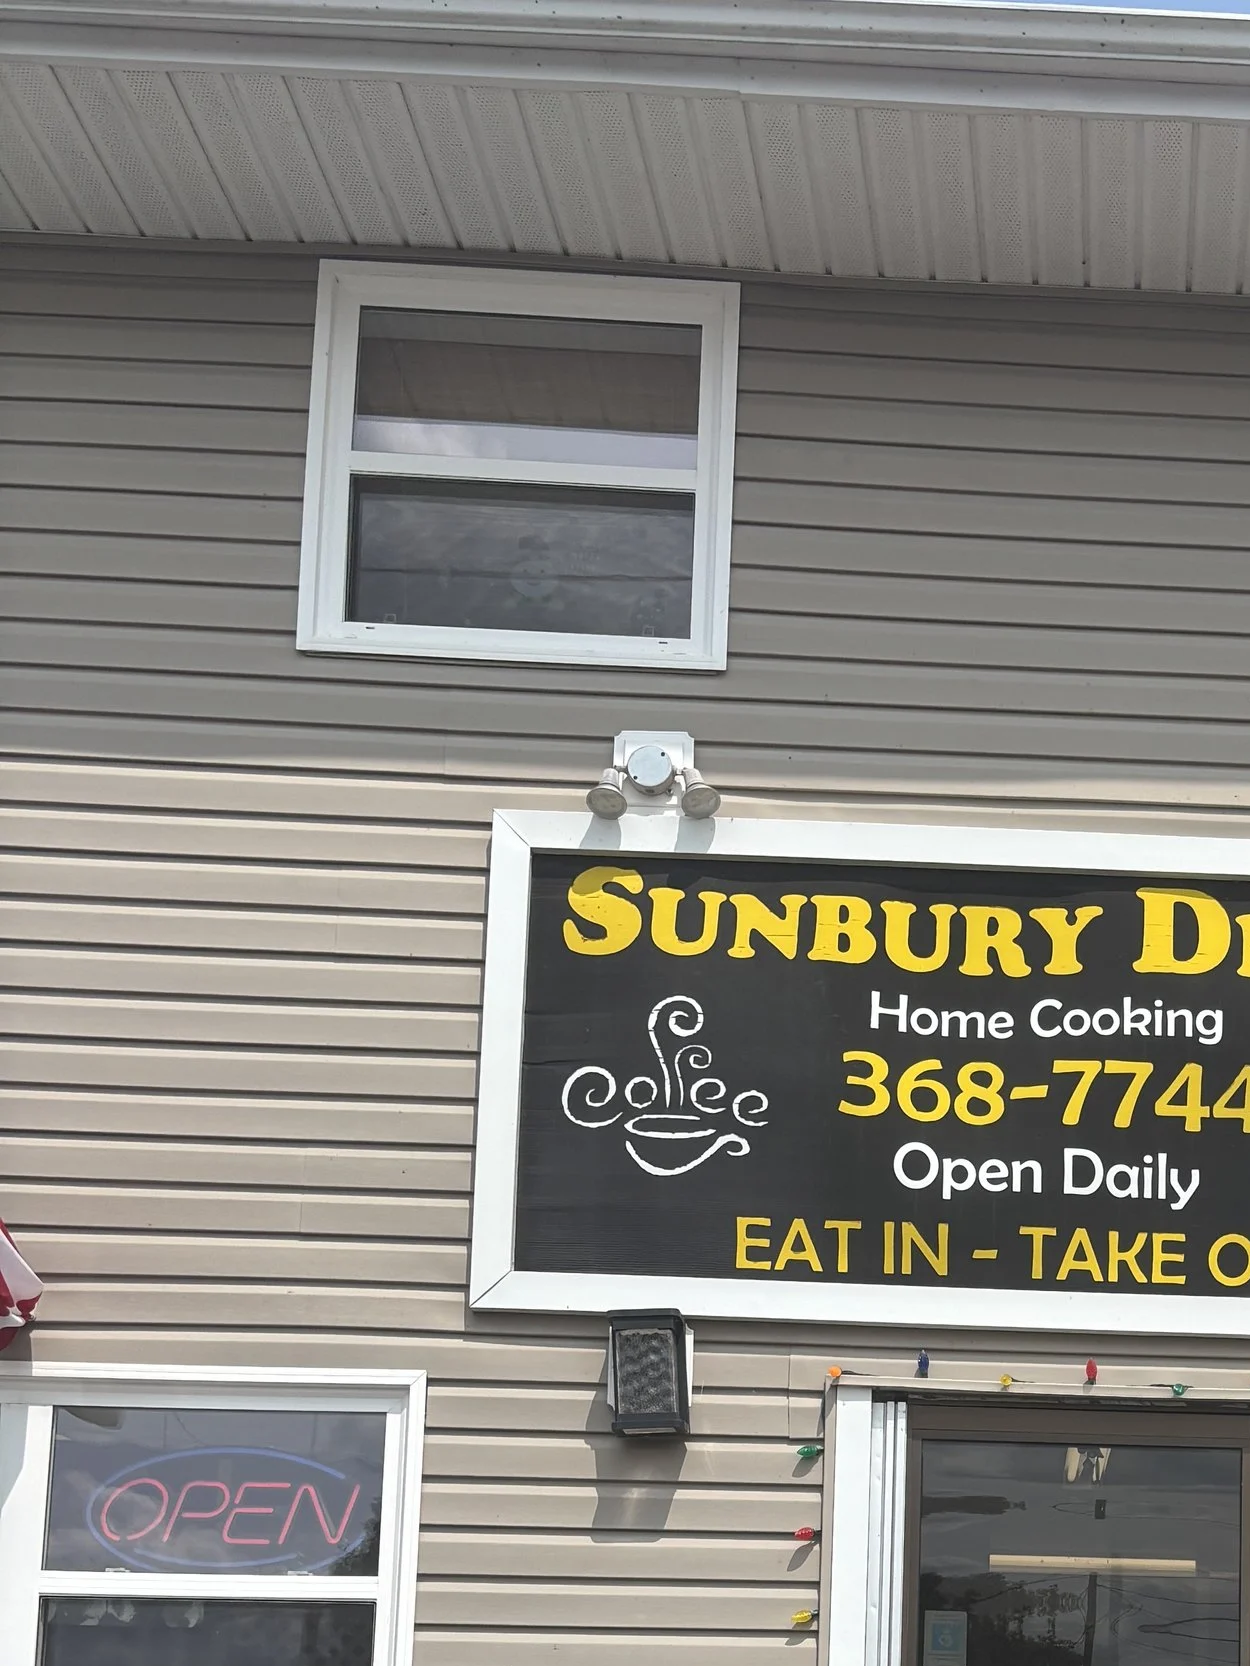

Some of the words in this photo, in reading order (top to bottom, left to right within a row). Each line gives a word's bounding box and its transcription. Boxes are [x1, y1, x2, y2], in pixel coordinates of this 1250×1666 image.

[562, 866, 1104, 978] SUNBURY
[869, 990, 1015, 1040] Home
[1029, 996, 1224, 1046] Cooking
[561, 994, 770, 1130] Coffee
[893, 1141, 1043, 1200] Open
[1063, 1147, 1200, 1211] Daily
[735, 1216, 862, 1273] EAT
[883, 1221, 949, 1276] IN
[1018, 1225, 1187, 1285] TAKE
[100, 1476, 361, 1546] OPEN
